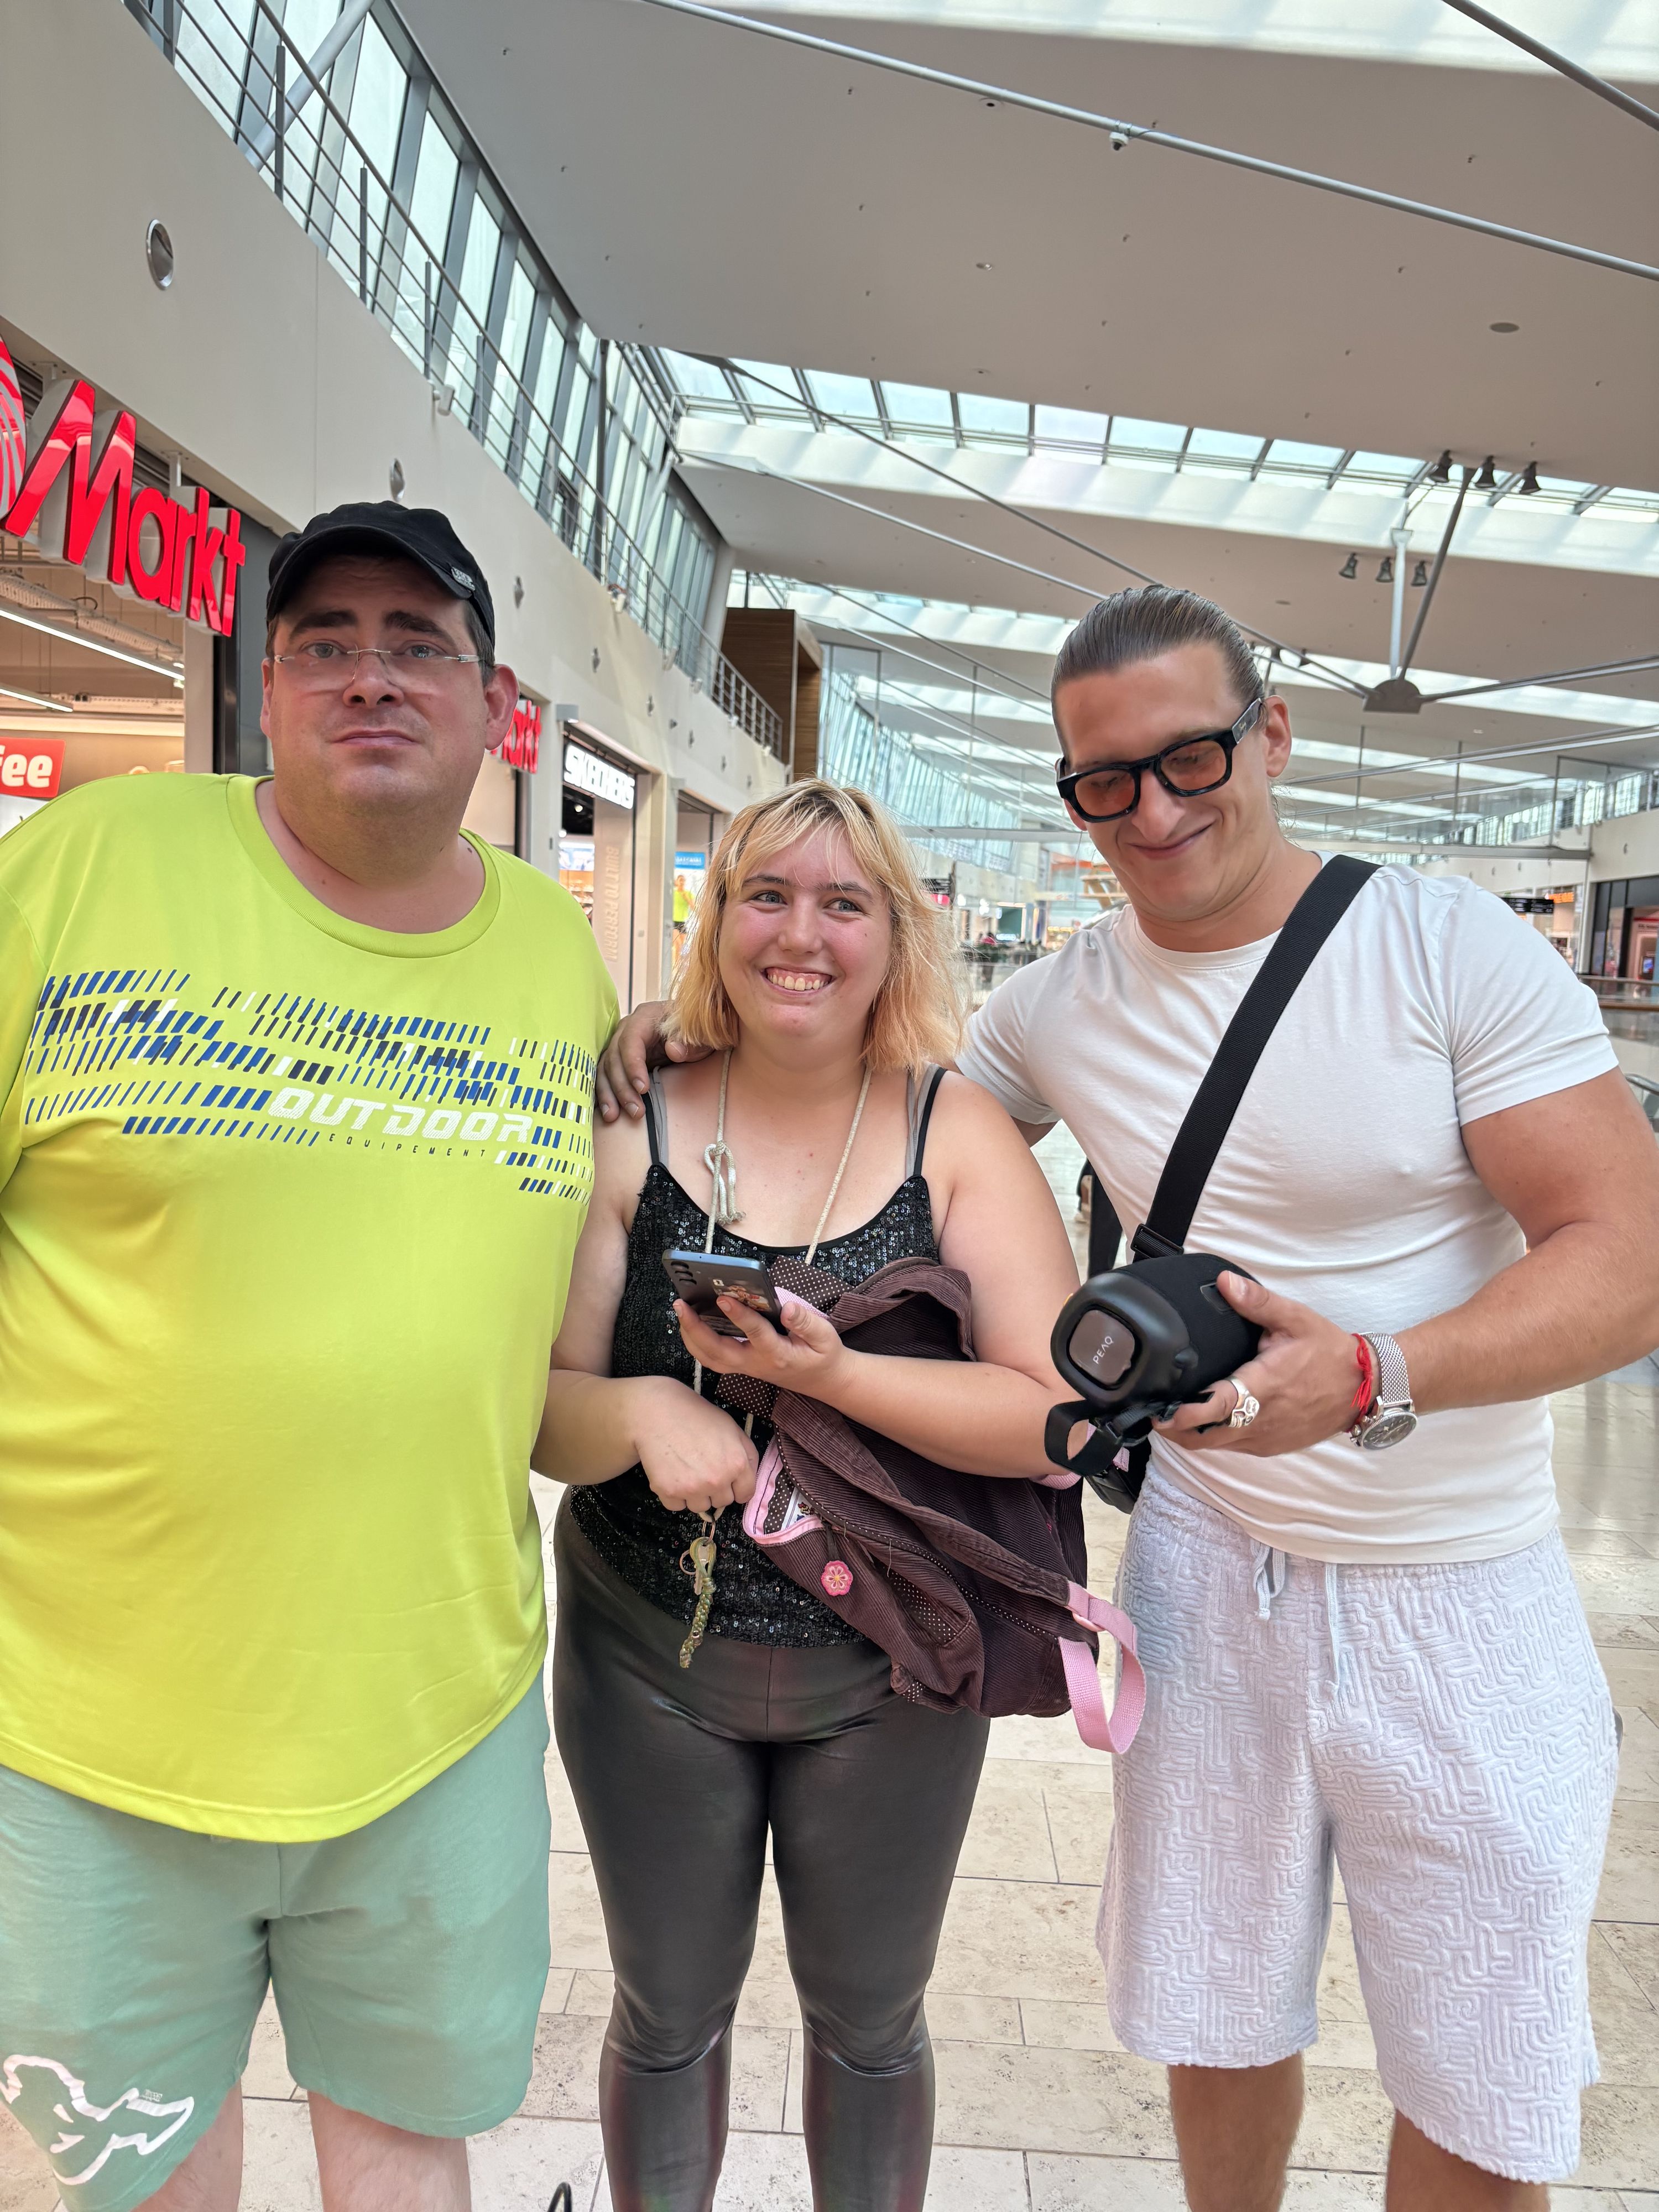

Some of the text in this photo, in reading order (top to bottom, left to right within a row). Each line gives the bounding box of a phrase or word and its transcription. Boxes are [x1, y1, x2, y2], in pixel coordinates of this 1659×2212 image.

[6, 379, 246, 637] Markt
[564, 744, 635, 809] SKECHERS
[268, 1087, 534, 1143] OUTDOOR
[329, 1133, 486, 1157] EQUIPEMENT
[1093, 1336, 1114, 1364] PEAQ
